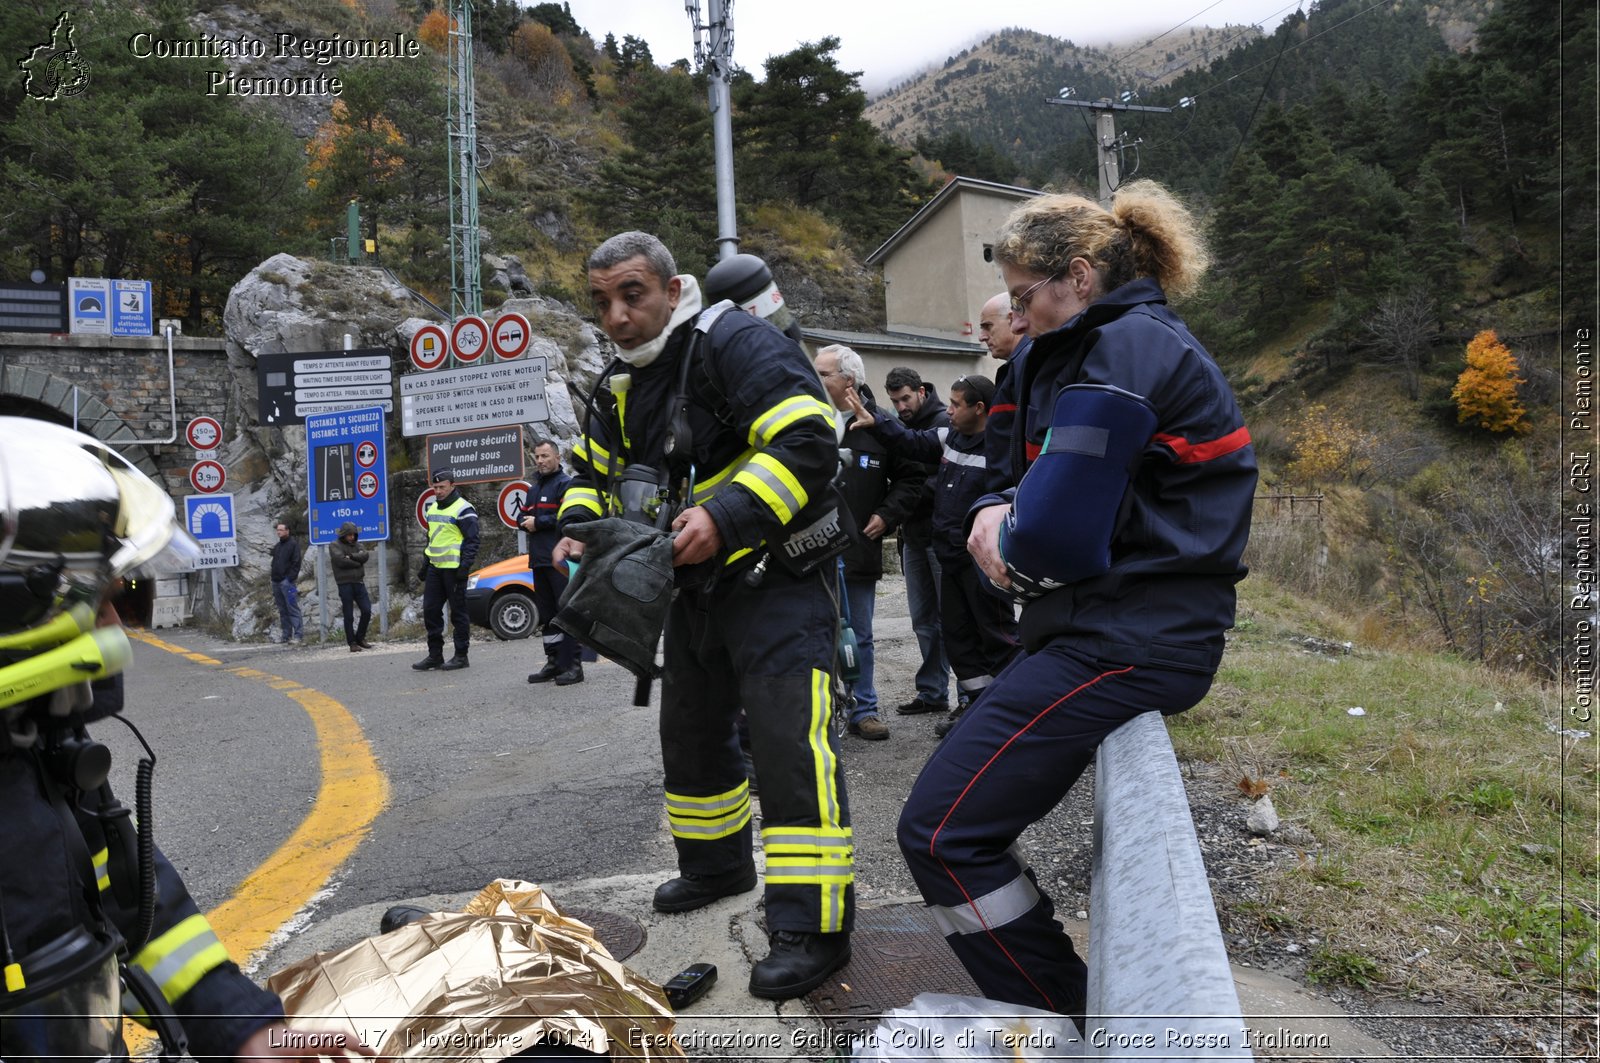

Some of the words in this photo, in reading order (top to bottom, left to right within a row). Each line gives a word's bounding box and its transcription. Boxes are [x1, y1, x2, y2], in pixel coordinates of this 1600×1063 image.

[353, 374, 370, 382] GREEN
[404, 383, 413, 391] EN
[415, 381, 428, 389] CAS
[430, 376, 457, 387] D'ARRET
[460, 372, 488, 383] STOPPEZ
[491, 369, 512, 379] VOTRE
[514, 365, 542, 376] MOTEUR
[304, 391, 320, 399] TEMPO
[422, 393, 434, 401] YOU
[436, 392, 450, 400] STOP
[453, 389, 474, 398] SWITCH
[476, 386, 492, 395] YOUR
[494, 383, 516, 393] ENGINE
[518, 381, 530, 389] OFF
[415, 405, 445, 416] SPEGNERE
[455, 401, 478, 410] MOTORE
[481, 399, 487, 407] IN
[489, 397, 505, 406] CASO
[507, 396, 514, 404] DI
[516, 393, 544, 403] FERMATA
[310, 418, 337, 428] DISTANZA
[339, 416, 346, 425] DI
[348, 412, 380, 424] SICUREZZA
[416, 420, 433, 428] BITTE
[435, 417, 460, 427] STELLEN
[476, 413, 489, 421] DEN
[491, 410, 513, 419] MOTOR
[311, 428, 338, 439] DISTANCE
[341, 426, 349, 435] DE
[350, 422, 379, 434] SÉCURITÉ
[432, 441, 453, 454] pour
[455, 438, 478, 450] votre
[480, 432, 518, 446] sécurité
[450, 451, 478, 464] tunnel
[480, 450, 501, 460] sous
[197, 471, 219, 482] 3,9m
[337, 508, 351, 517] 150
[200, 557, 218, 565] 3200
